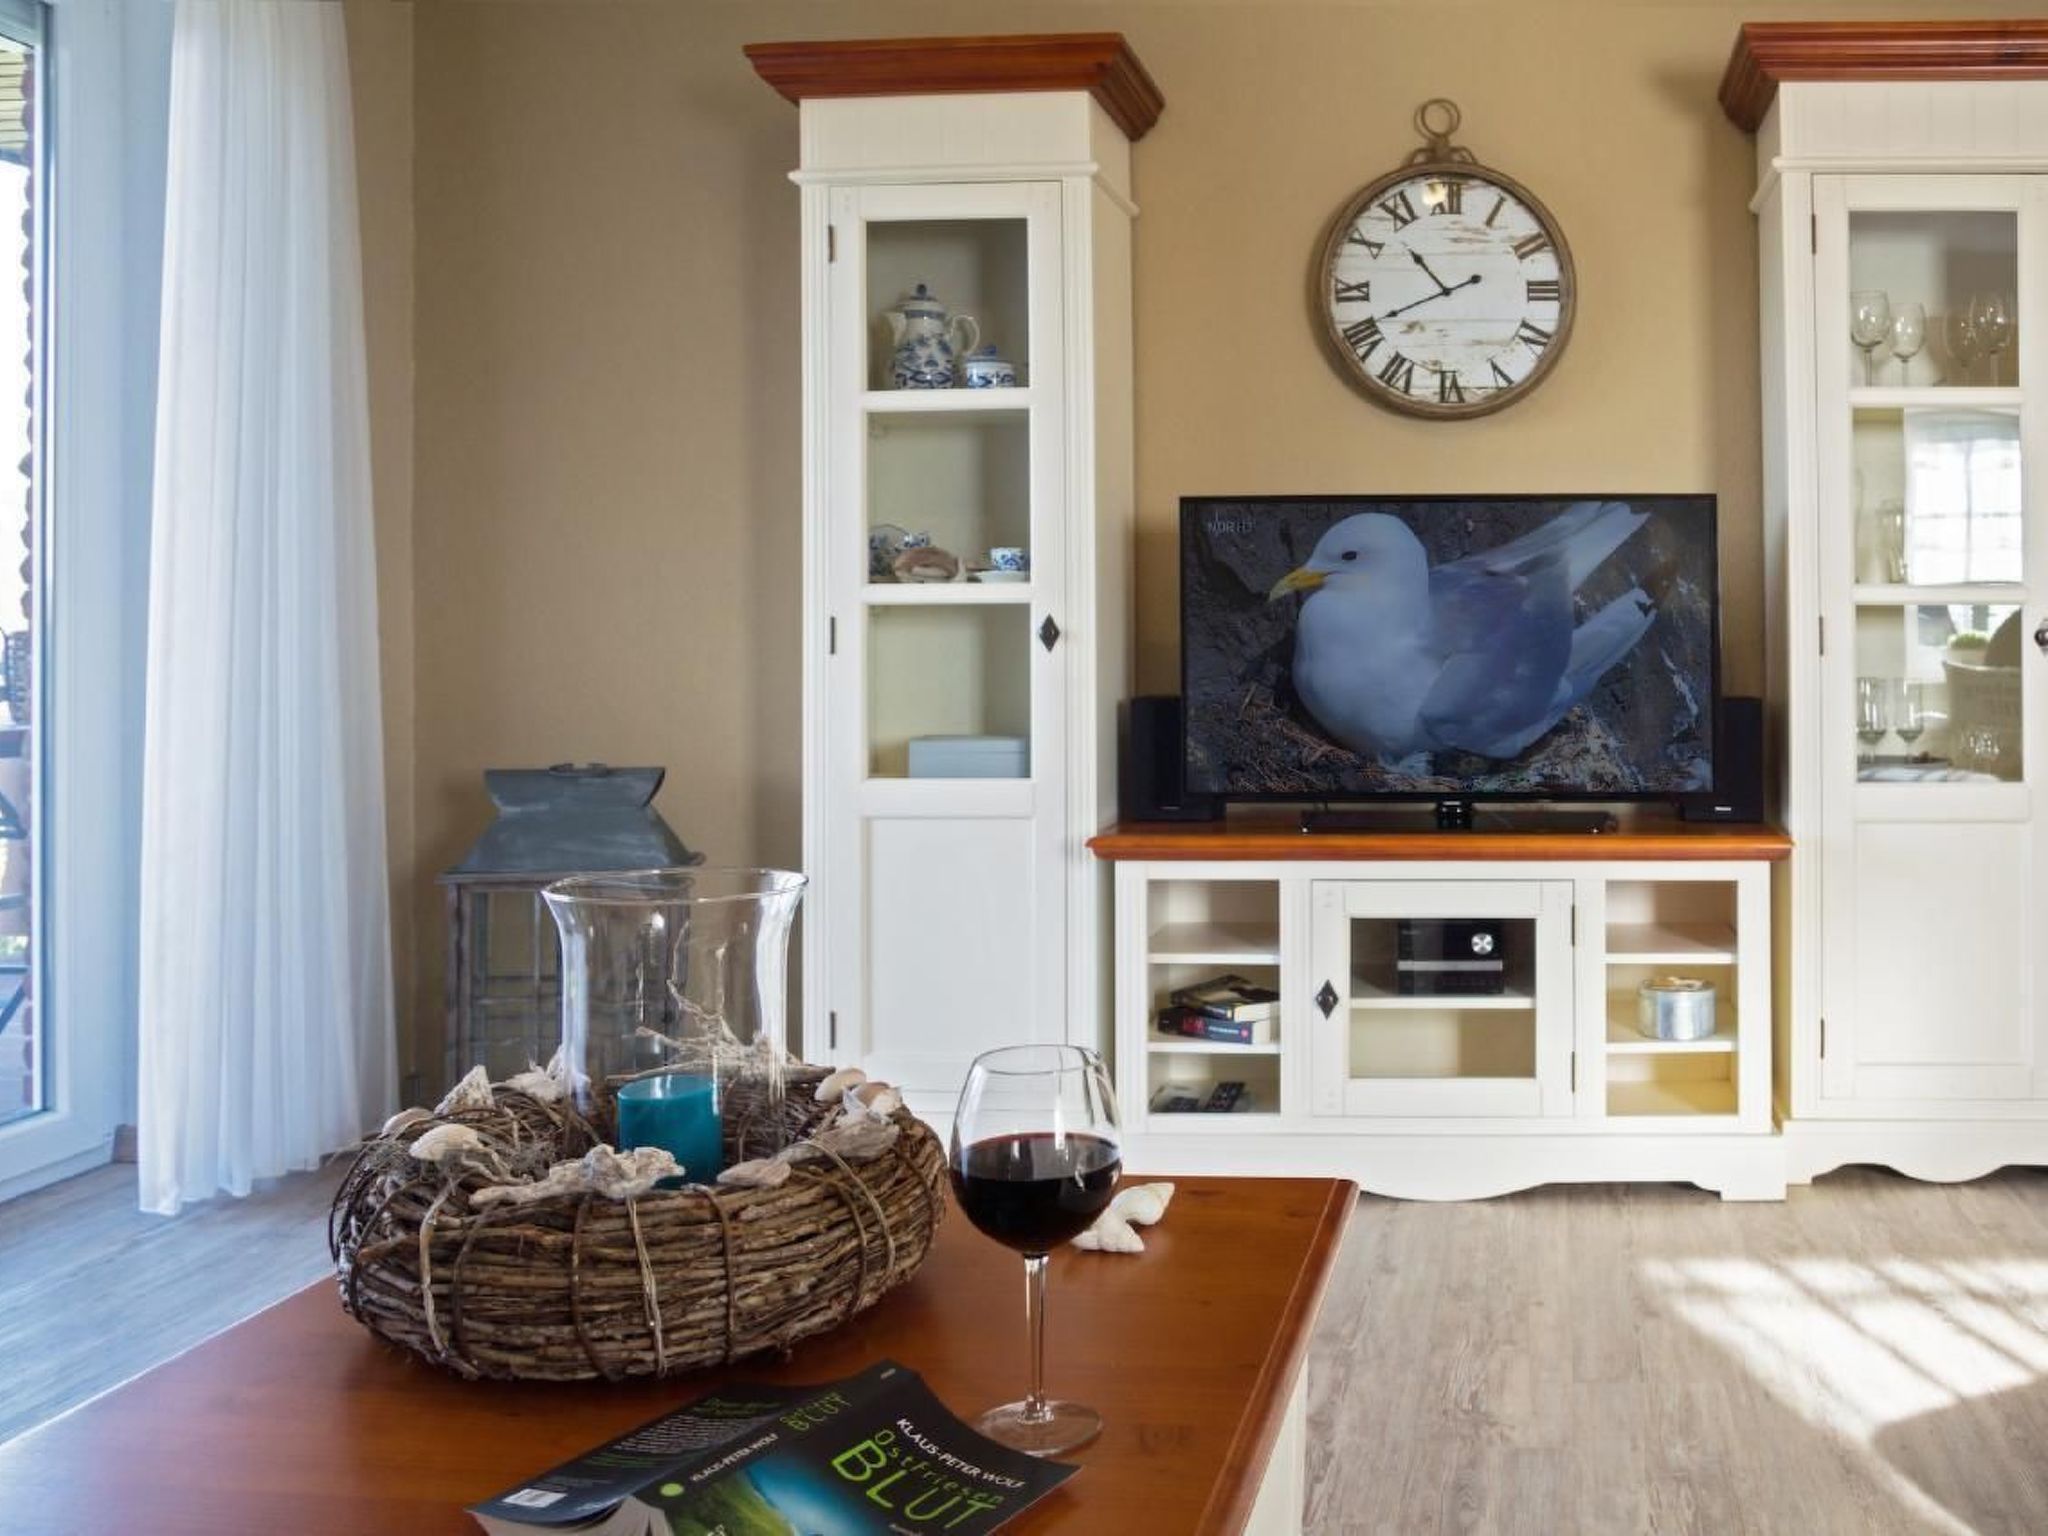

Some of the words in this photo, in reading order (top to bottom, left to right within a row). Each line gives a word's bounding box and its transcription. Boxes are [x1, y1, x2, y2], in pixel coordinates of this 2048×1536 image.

[1378, 189, 1419, 232] XI
[1348, 228, 1385, 260] X
[1511, 230, 1550, 262] II
[1334, 278, 1370, 304] IX
[1526, 280, 1560, 302] III
[1342, 314, 1386, 364] VIII
[1512, 317, 1552, 359] IV
[1376, 350, 1415, 395] VII
[1439, 370, 1466, 404] VI
[1487, 355, 1515, 388] V
[896, 1418, 982, 1479] KLAUS-PETER
[981, 1470, 1027, 1490] WOLF
[831, 1439, 997, 1530] BLUT
